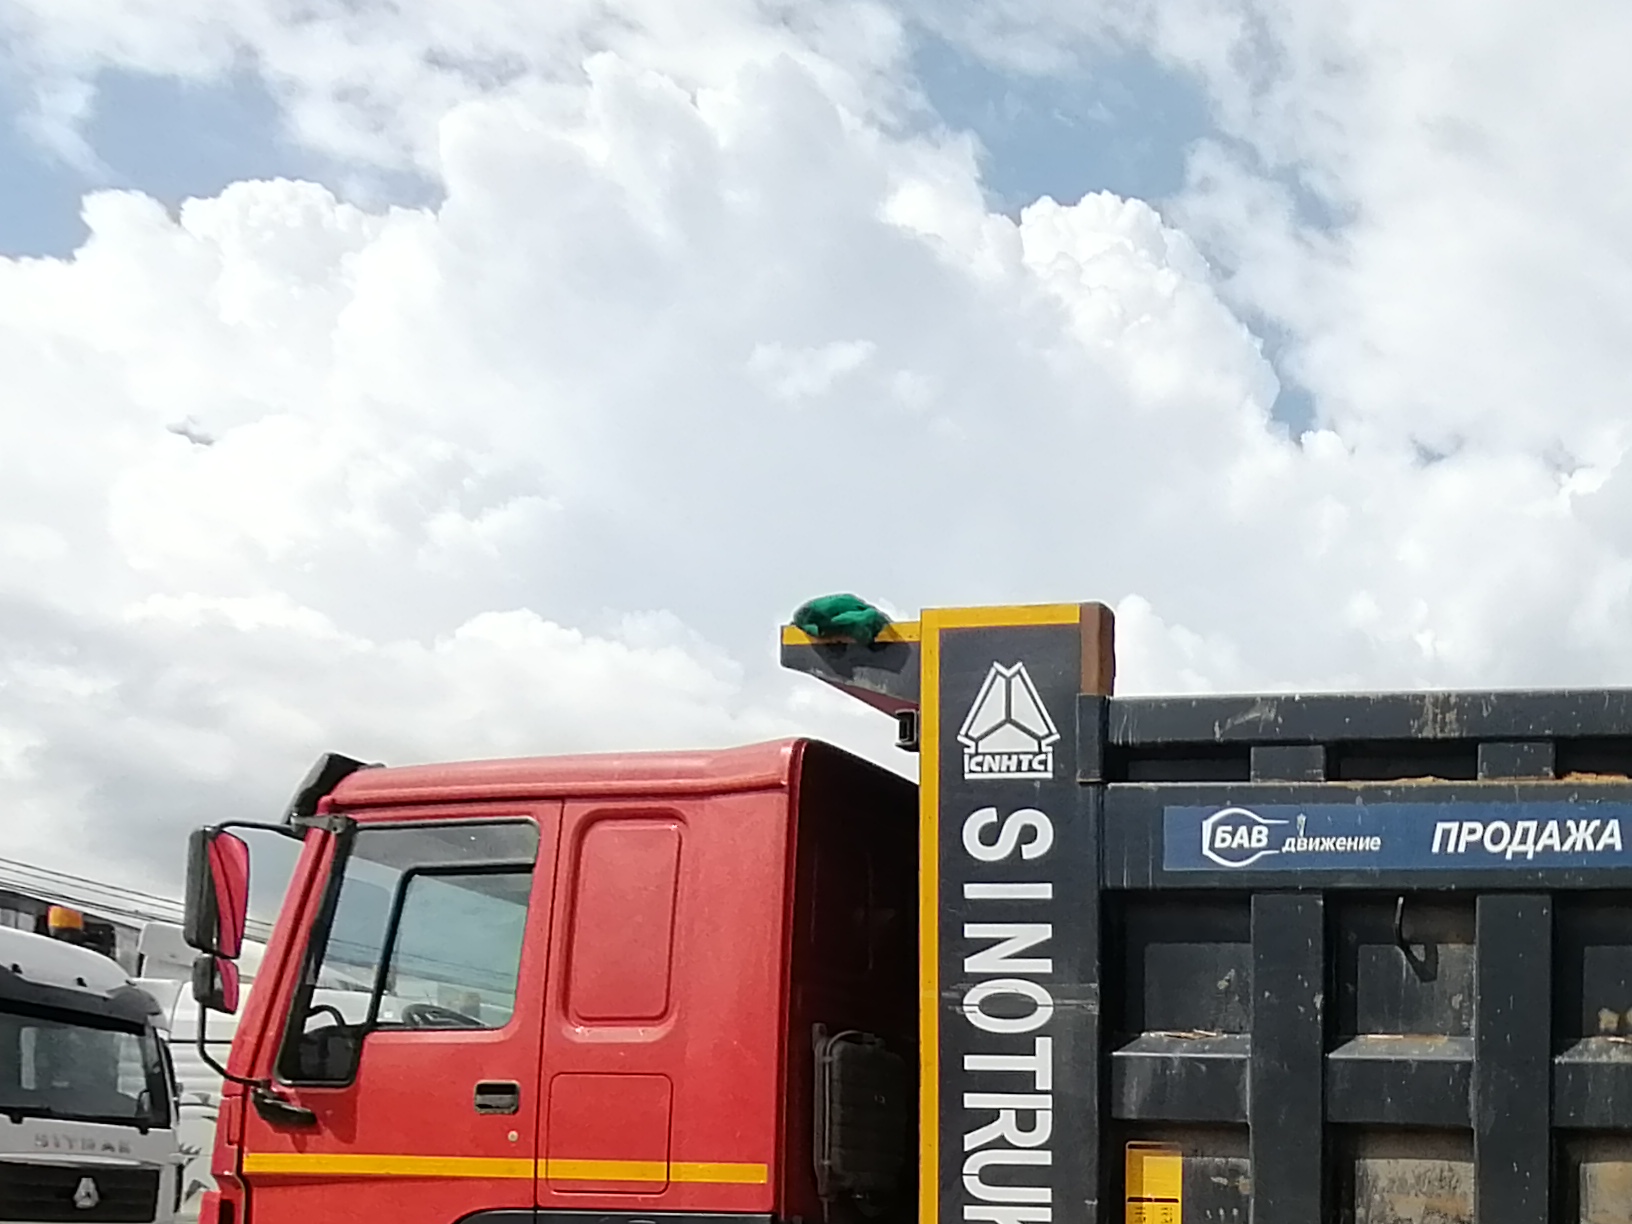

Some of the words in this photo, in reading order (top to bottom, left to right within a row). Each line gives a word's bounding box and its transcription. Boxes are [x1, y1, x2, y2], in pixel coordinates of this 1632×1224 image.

[969, 753, 1048, 773] CNHTC
[1214, 825, 1269, 849] БАВ
[1281, 835, 1382, 853] движение
[1431, 819, 1624, 861] ПРОДАЖА
